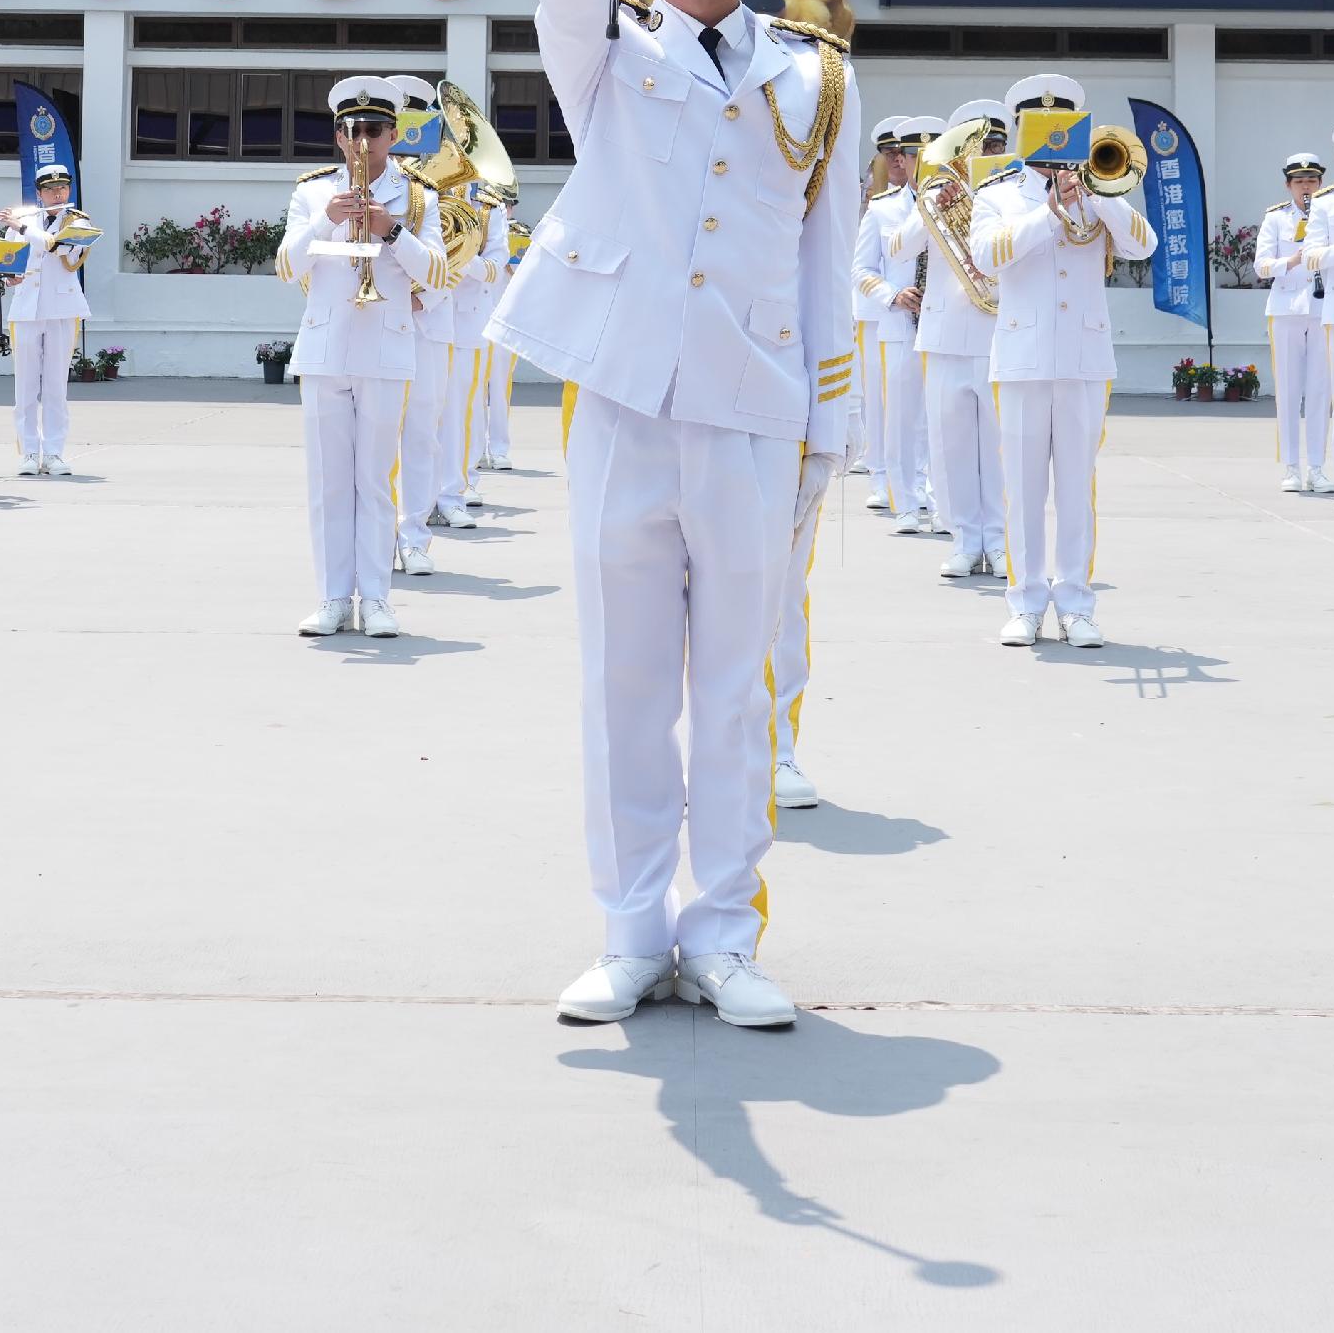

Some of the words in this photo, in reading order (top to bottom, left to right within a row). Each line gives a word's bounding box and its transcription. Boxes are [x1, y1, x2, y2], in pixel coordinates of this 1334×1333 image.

[1160, 157, 1189, 305] 香港懲教學院
